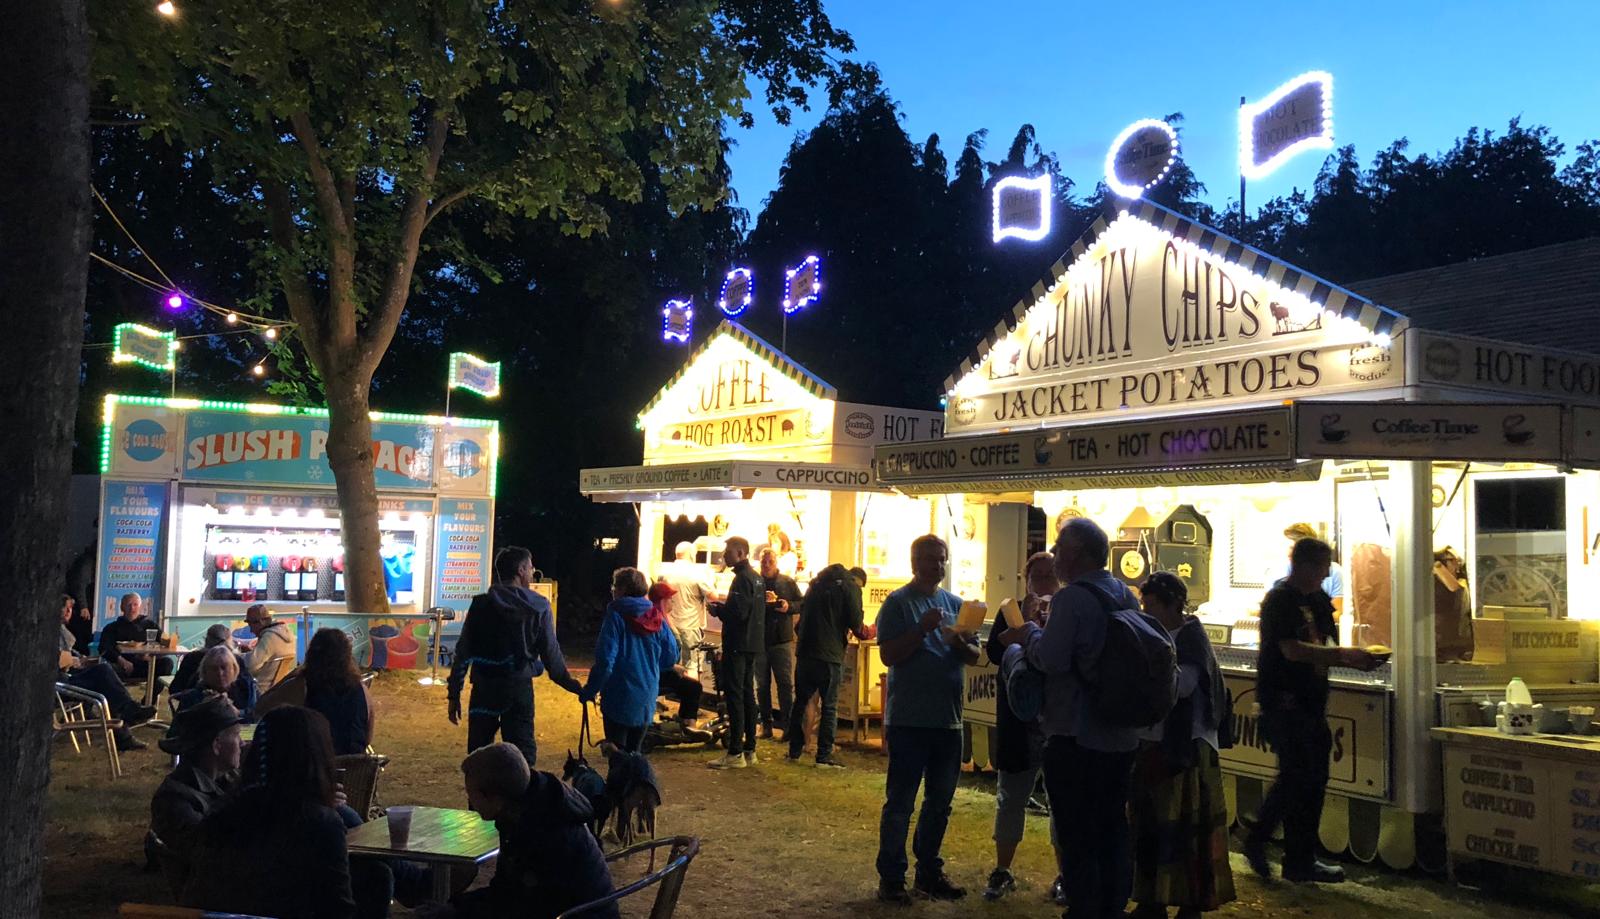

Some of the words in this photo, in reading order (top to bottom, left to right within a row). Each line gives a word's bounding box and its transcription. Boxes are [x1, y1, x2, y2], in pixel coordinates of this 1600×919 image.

[1026, 248, 1137, 372] CHUNKY
[1161, 240, 1260, 351] CHIPS
[1350, 353, 1391, 365] fresh
[1475, 347, 1531, 386] HOT
[1542, 355, 1600, 394] FOO
[994, 377, 1109, 421] JACKET
[1119, 350, 1320, 407] POTATOES
[685, 423, 714, 448] HOG
[721, 415, 777, 445] ROAST
[883, 414, 919, 441] HOT
[1372, 418, 1430, 434] Coffee
[1431, 418, 1479, 435] Time
[186, 429, 294, 471] SLUSH
[886, 450, 957, 473] CAPPUCCINO
[970, 443, 1019, 467] COFFEE
[1067, 439, 1098, 460] TEA
[1118, 434, 1151, 457] HOT
[1160, 423, 1269, 455] CHOCOLATE
[608, 473, 635, 486] FRESHLY
[636, 471, 662, 484] GROUND
[664, 469, 690, 482] COFFEE
[700, 468, 721, 481] LATTE
[776, 468, 869, 485] CAPPUCCINO
[1083, 473, 1171, 487] TRADITIONAL
[123, 496, 149, 506] YOUR
[245, 495, 264, 505] ICE
[272, 496, 303, 506] COLD
[457, 502, 474, 510] MIX
[110, 506, 159, 516] FLAVOURS
[453, 512, 476, 521] YOUR
[443, 523, 485, 533] FLAVOURS
[107, 582, 154, 590] BLACKCURRANT
[870, 588, 892, 604] FRES
[1512, 631, 1530, 649] HOT
[1530, 631, 1579, 649] CHOCOLATE
[1466, 833, 1540, 865] CHOCOLATE
